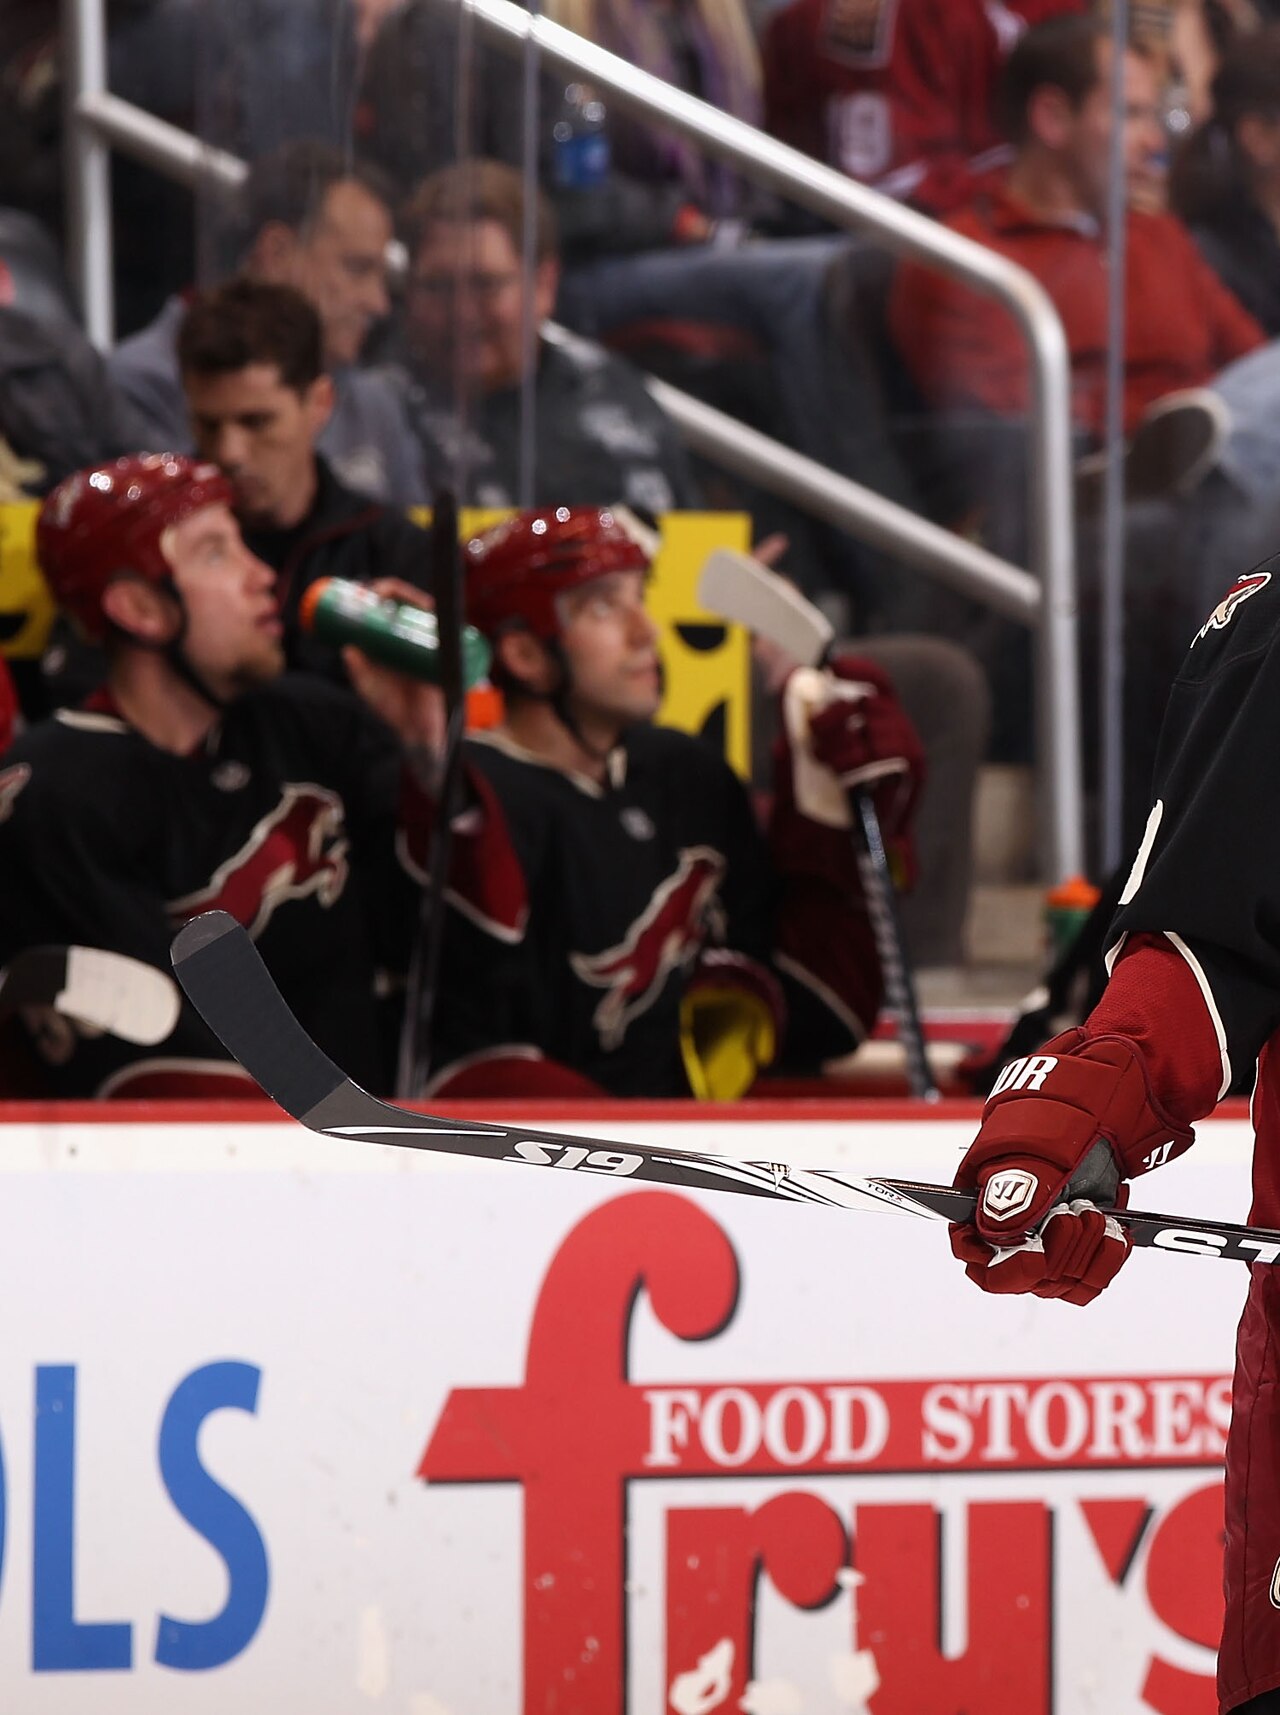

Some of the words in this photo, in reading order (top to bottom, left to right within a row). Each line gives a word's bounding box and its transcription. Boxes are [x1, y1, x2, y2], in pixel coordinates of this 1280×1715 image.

[502, 1140, 645, 1177] S19
[866, 1183, 905, 1203] TORX
[642, 1386, 889, 1468] FOOD
[0, 1358, 271, 1673] LS
